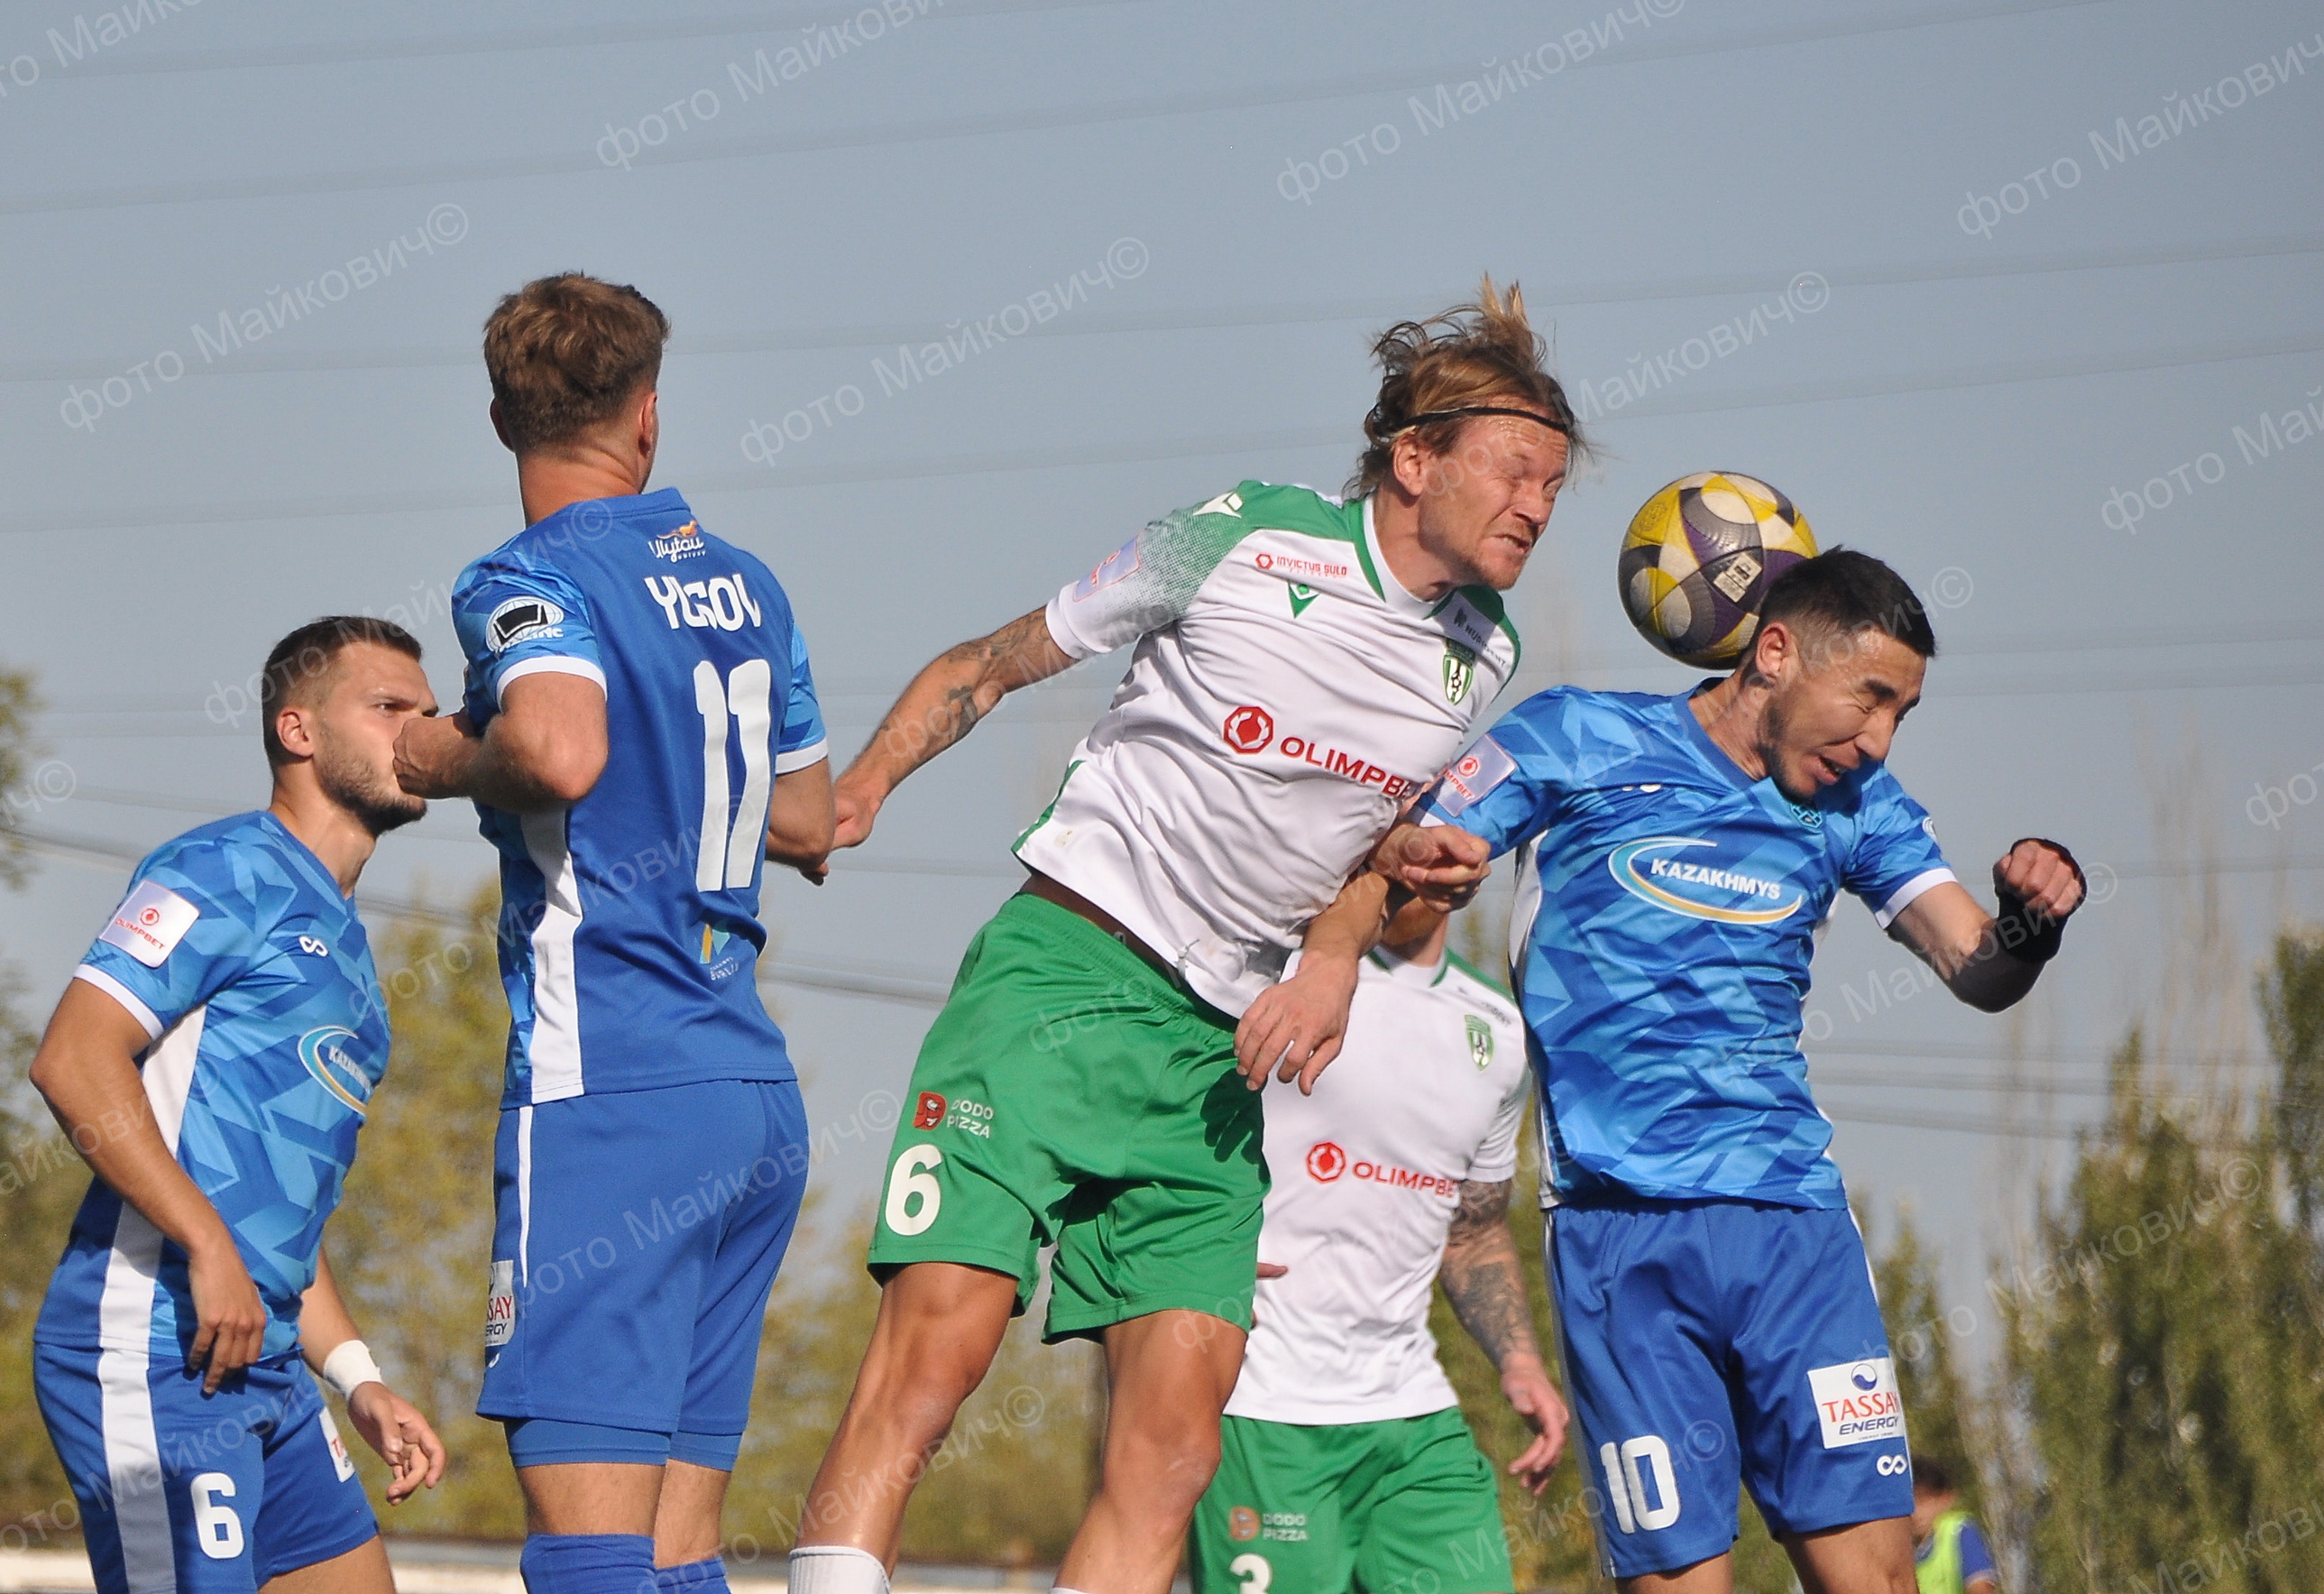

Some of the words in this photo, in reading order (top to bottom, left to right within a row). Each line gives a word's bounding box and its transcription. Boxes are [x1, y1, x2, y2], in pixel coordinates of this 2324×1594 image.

[1276, 556, 1320, 571] INVICTUS
[694, 659, 770, 892] 11
[1650, 858, 1783, 900] KAZAKHMYS
[115, 918, 165, 950] OLIMPBET
[946, 1114, 990, 1139] PIZZA
[951, 1099, 994, 1120] DODO
[886, 1143, 942, 1236] 6
[1353, 1162, 1458, 1198] OLIMPBE
[1839, 1416, 1899, 1435] ENERGY
[1600, 1435, 1681, 1534] 10
[190, 1471, 246, 1560] 6
